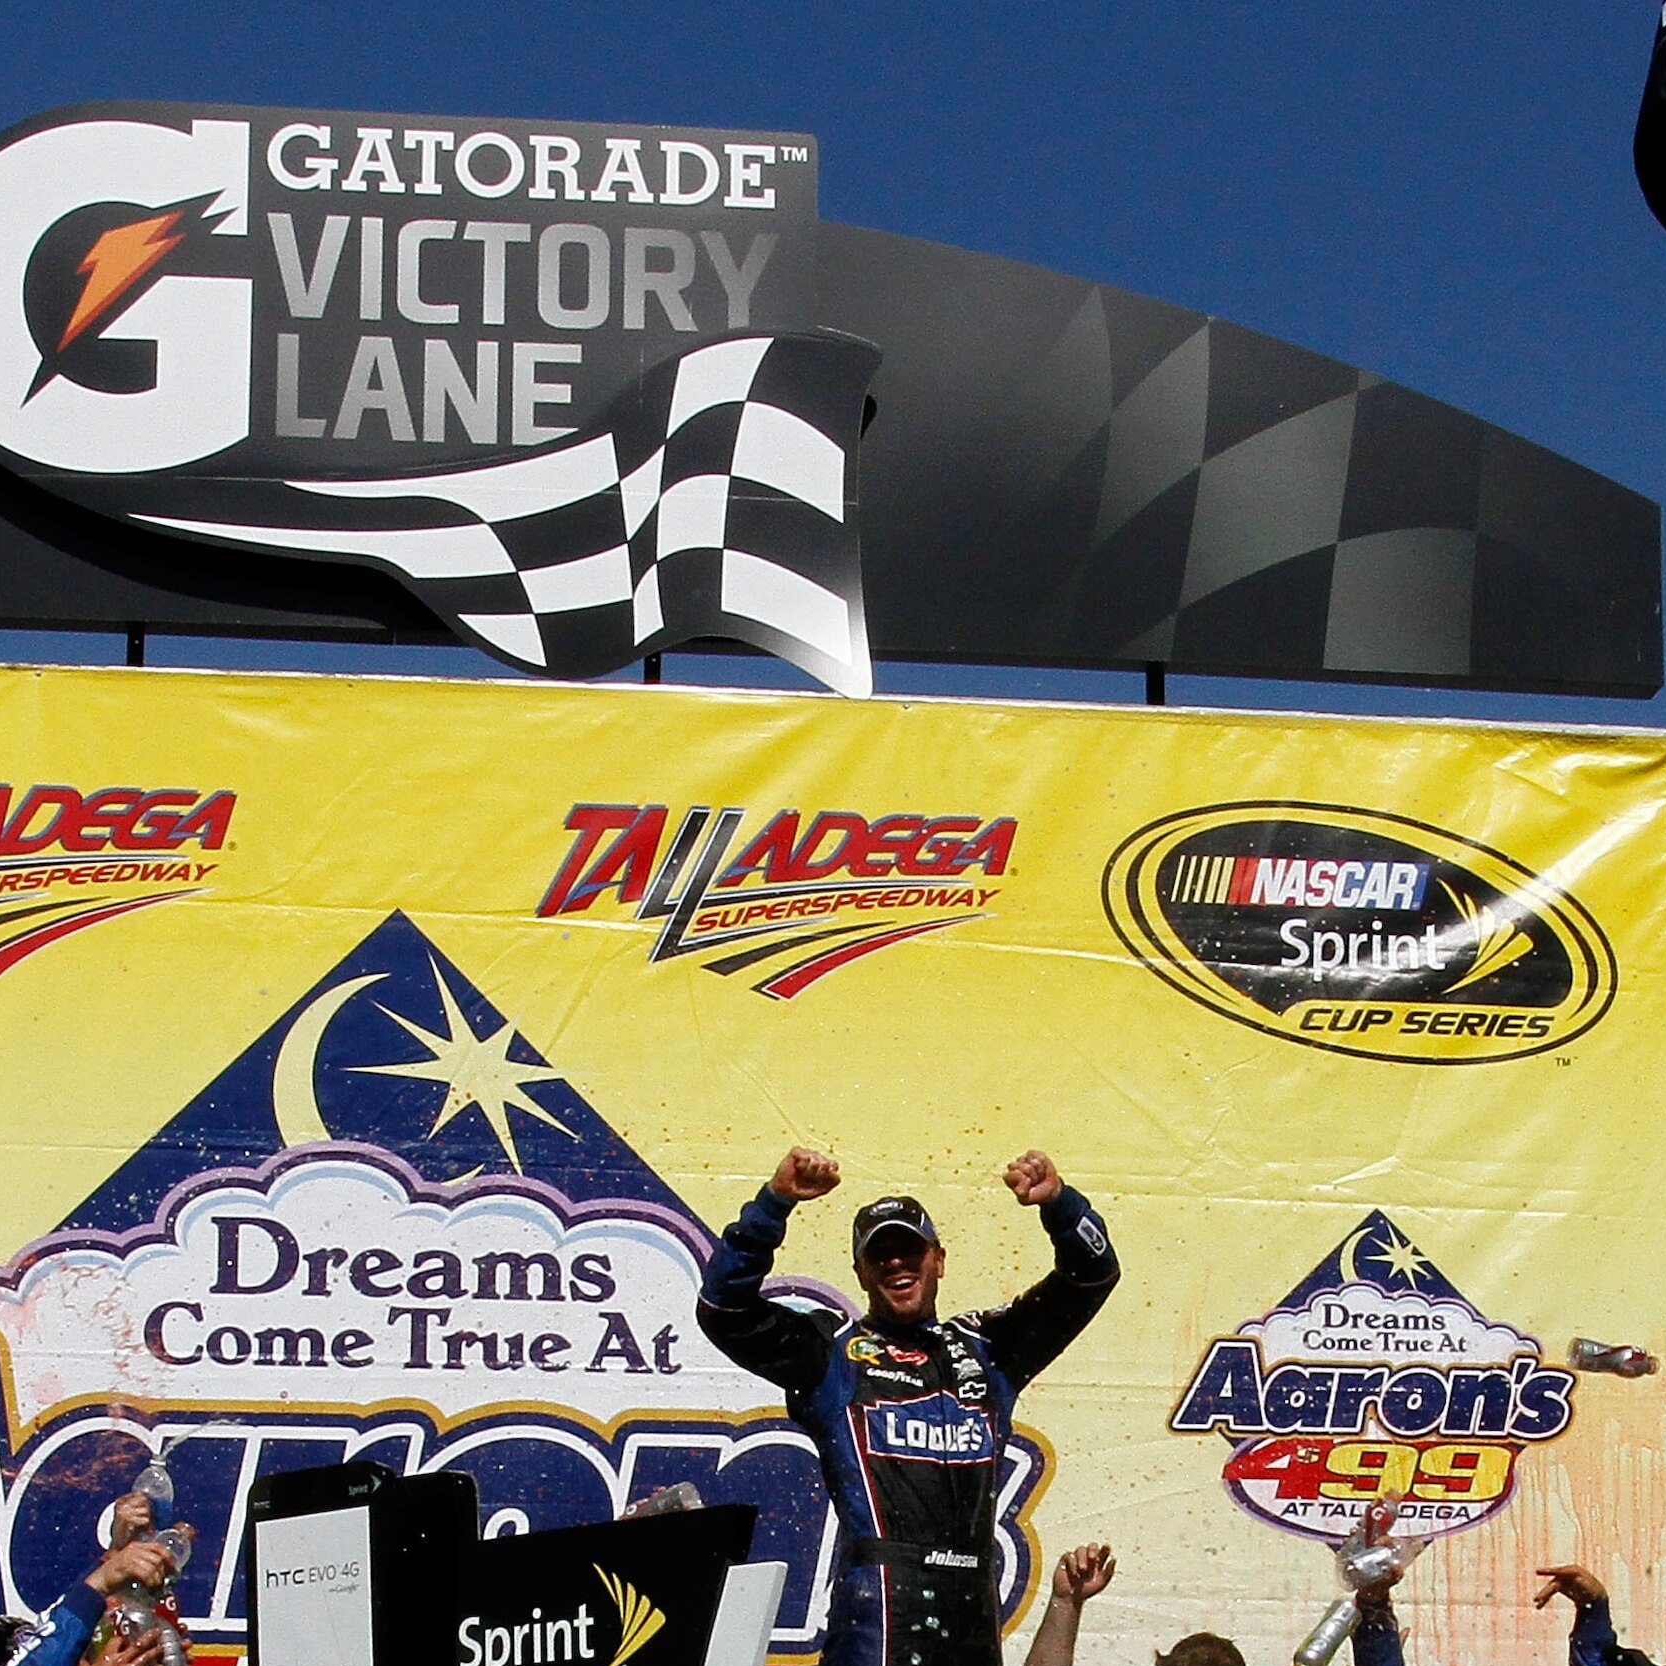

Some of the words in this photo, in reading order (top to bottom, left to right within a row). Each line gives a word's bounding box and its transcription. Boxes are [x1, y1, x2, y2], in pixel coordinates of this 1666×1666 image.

[267, 213, 780, 332] VICTORY
[275, 333, 585, 445] LANE
[535, 804, 1019, 964] TALLADEGA
[1250, 858, 1420, 910] NASCAR
[694, 889, 1000, 933] SUPERSPEEDWAY
[1279, 918, 1445, 981] Sprint
[1299, 1008, 1391, 1034] CUP
[1400, 1011, 1554, 1038] SERIES
[211, 1217, 617, 1301] Dreams
[144, 1303, 374, 1368] Come
[388, 1306, 572, 1373] True
[586, 1312, 681, 1374] At
[1303, 1332, 1373, 1352] Come
[1377, 1333, 1434, 1352] True
[1438, 1333, 1467, 1353] At
[1322, 1305, 1445, 1332] Dreams
[866, 1367, 923, 1387] GOODYEAR
[1170, 1341, 1575, 1438] Aaron's
[1281, 1503, 1315, 1517] AT
[1320, 1503, 1470, 1520] TALDEGA
[309, 1566, 336, 1582] EVO
[341, 1562, 360, 1578] 4G
